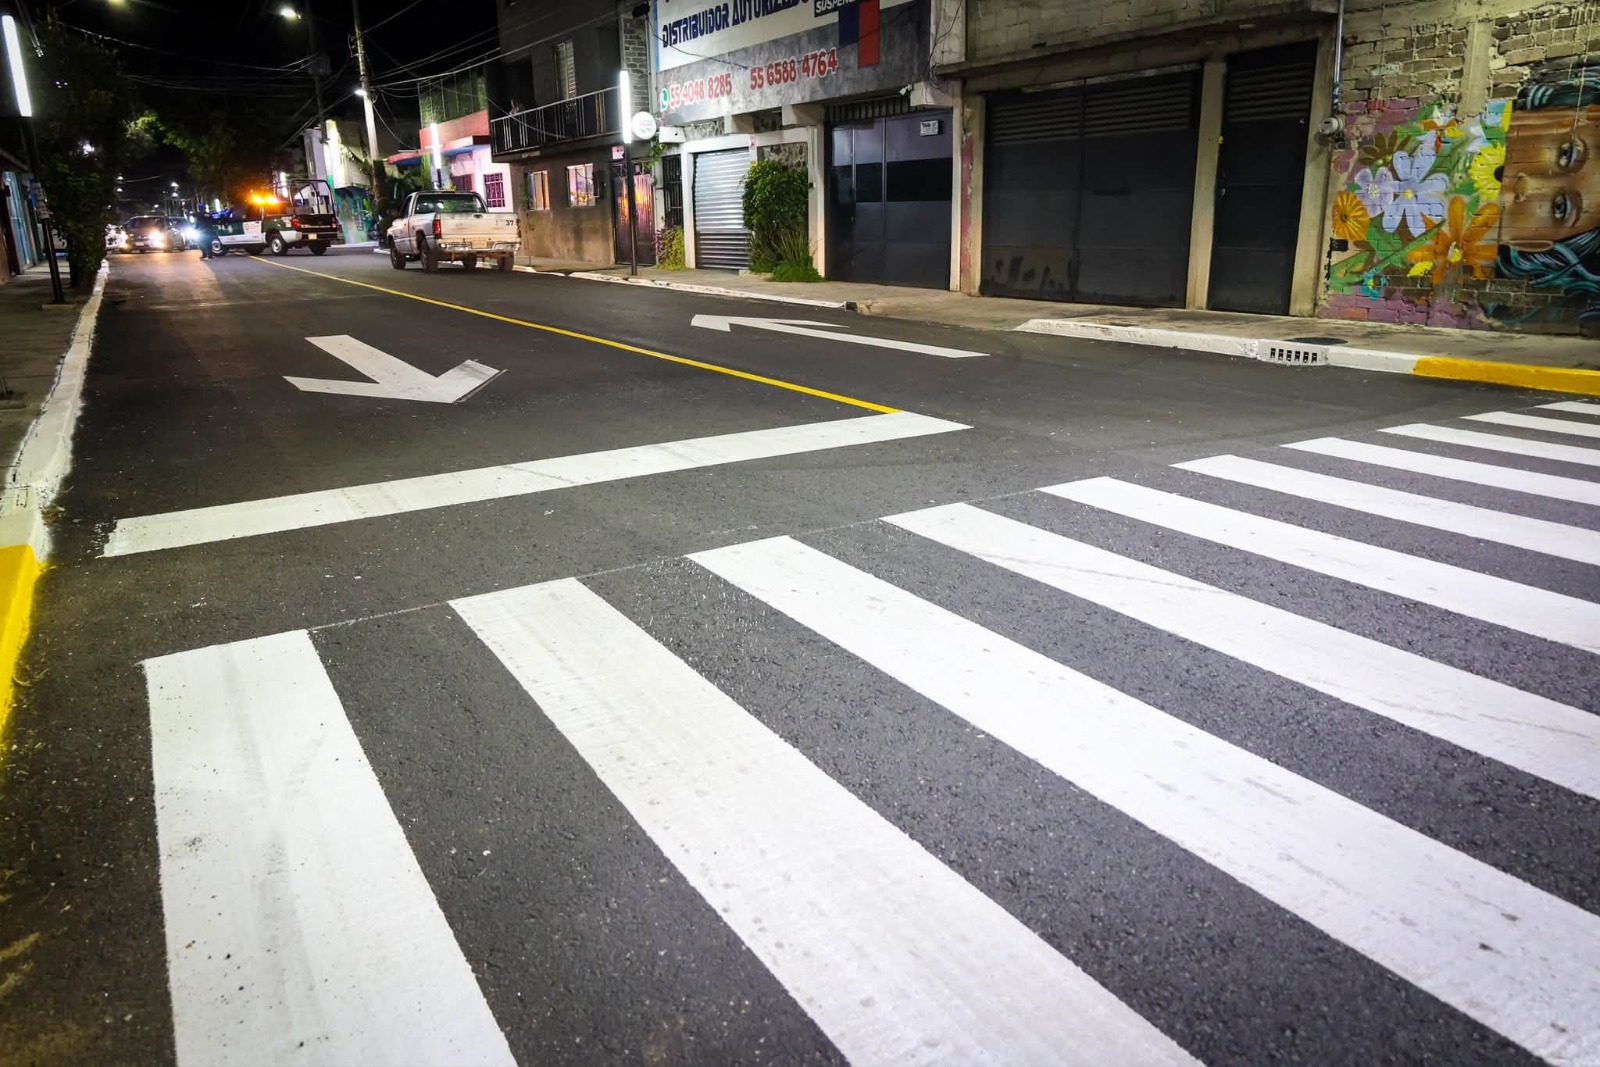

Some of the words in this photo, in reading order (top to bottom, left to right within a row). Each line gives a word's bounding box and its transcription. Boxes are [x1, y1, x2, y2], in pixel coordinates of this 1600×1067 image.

[662, 2, 730, 48] DISTRIBUIDOR
[670, 84, 681, 108] 55
[682, 80, 705, 105] 4048
[707, 73, 732, 99] 8285
[750, 67, 764, 90] 55
[767, 58, 797, 87] 6588
[801, 48, 838, 78] 4764
